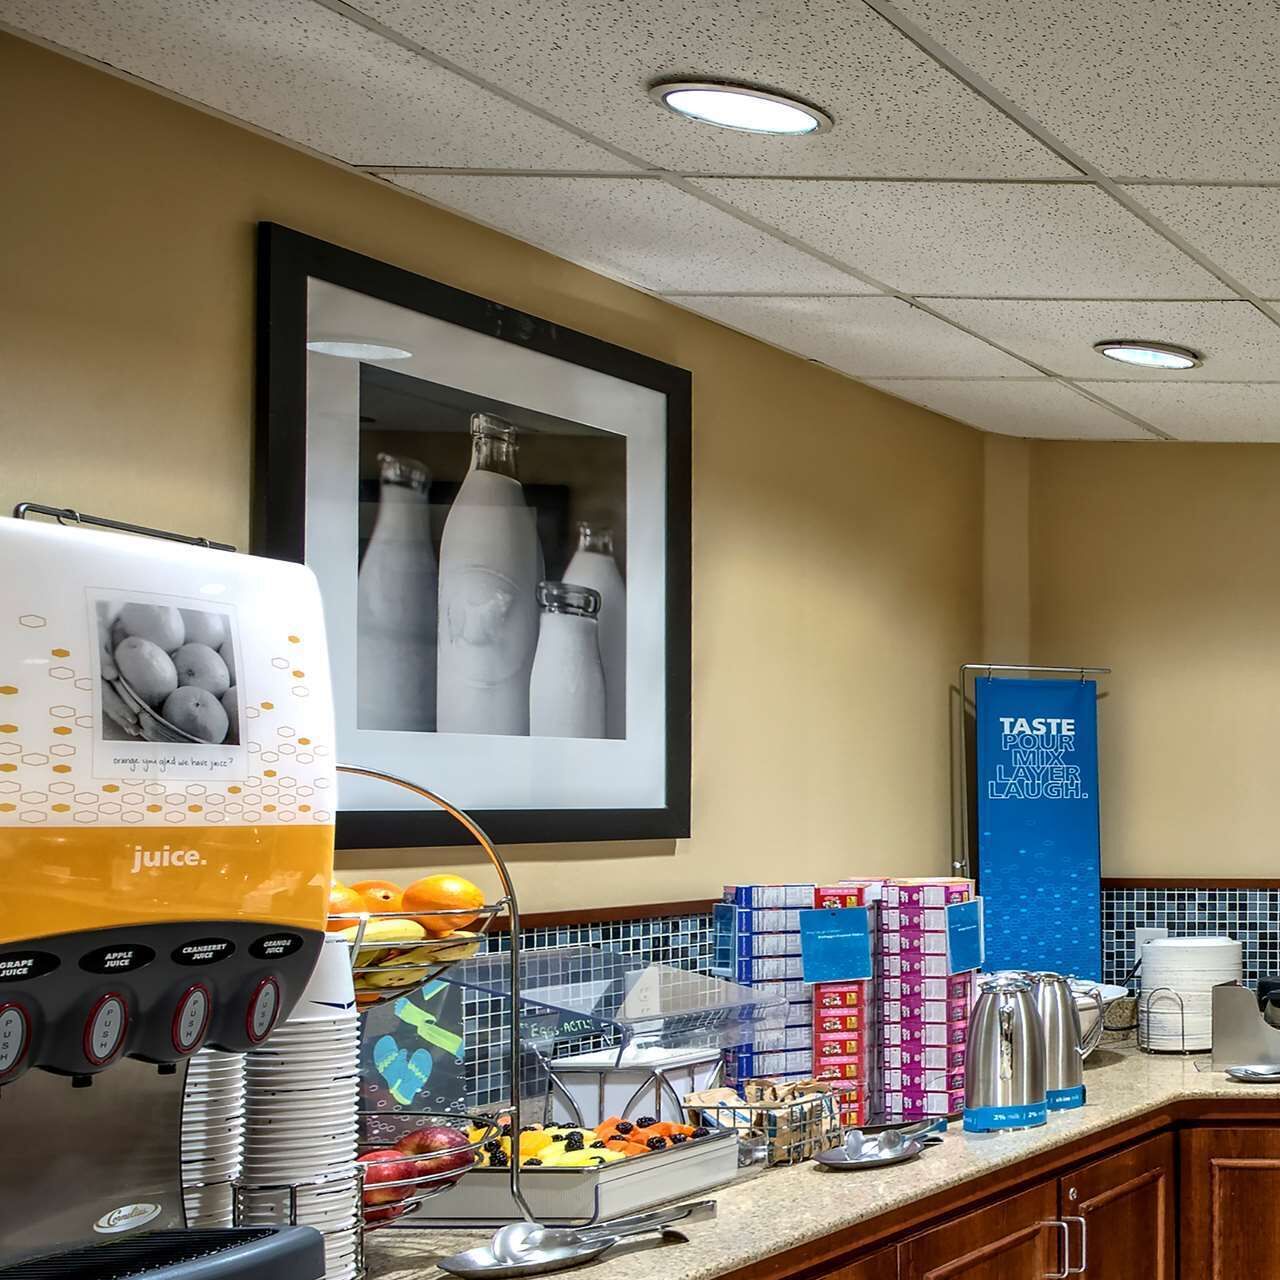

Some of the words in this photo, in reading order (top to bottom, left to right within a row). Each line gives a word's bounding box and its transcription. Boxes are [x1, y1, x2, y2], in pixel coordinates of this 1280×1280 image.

[999, 717, 1076, 736] TASTE
[1001, 733, 1076, 752] POUR
[112, 757, 140, 772] orange
[142, 759, 157, 772] you
[159, 756, 176, 773] glad
[191, 756, 208, 767] have
[210, 757, 234, 771] juice?
[1011, 749, 1066, 768] MIX
[996, 764, 1081, 783] LAYER
[988, 781, 1089, 800] LAUGH.
[130, 845, 208, 874] juice.
[104, 951, 133, 961] APPLE
[182, 943, 228, 954] CRANBERRY
[192, 952, 214, 960] JUICE
[265, 946, 285, 954] JUICE
[0, 959, 34, 970] GRAPE
[0, 967, 29, 977] JUICE
[104, 958, 131, 968] JUICE
[100, 1008, 115, 1049] PUSH
[185, 1000, 199, 1039] PUSH
[0, 1019, 13, 1060] PUSH
